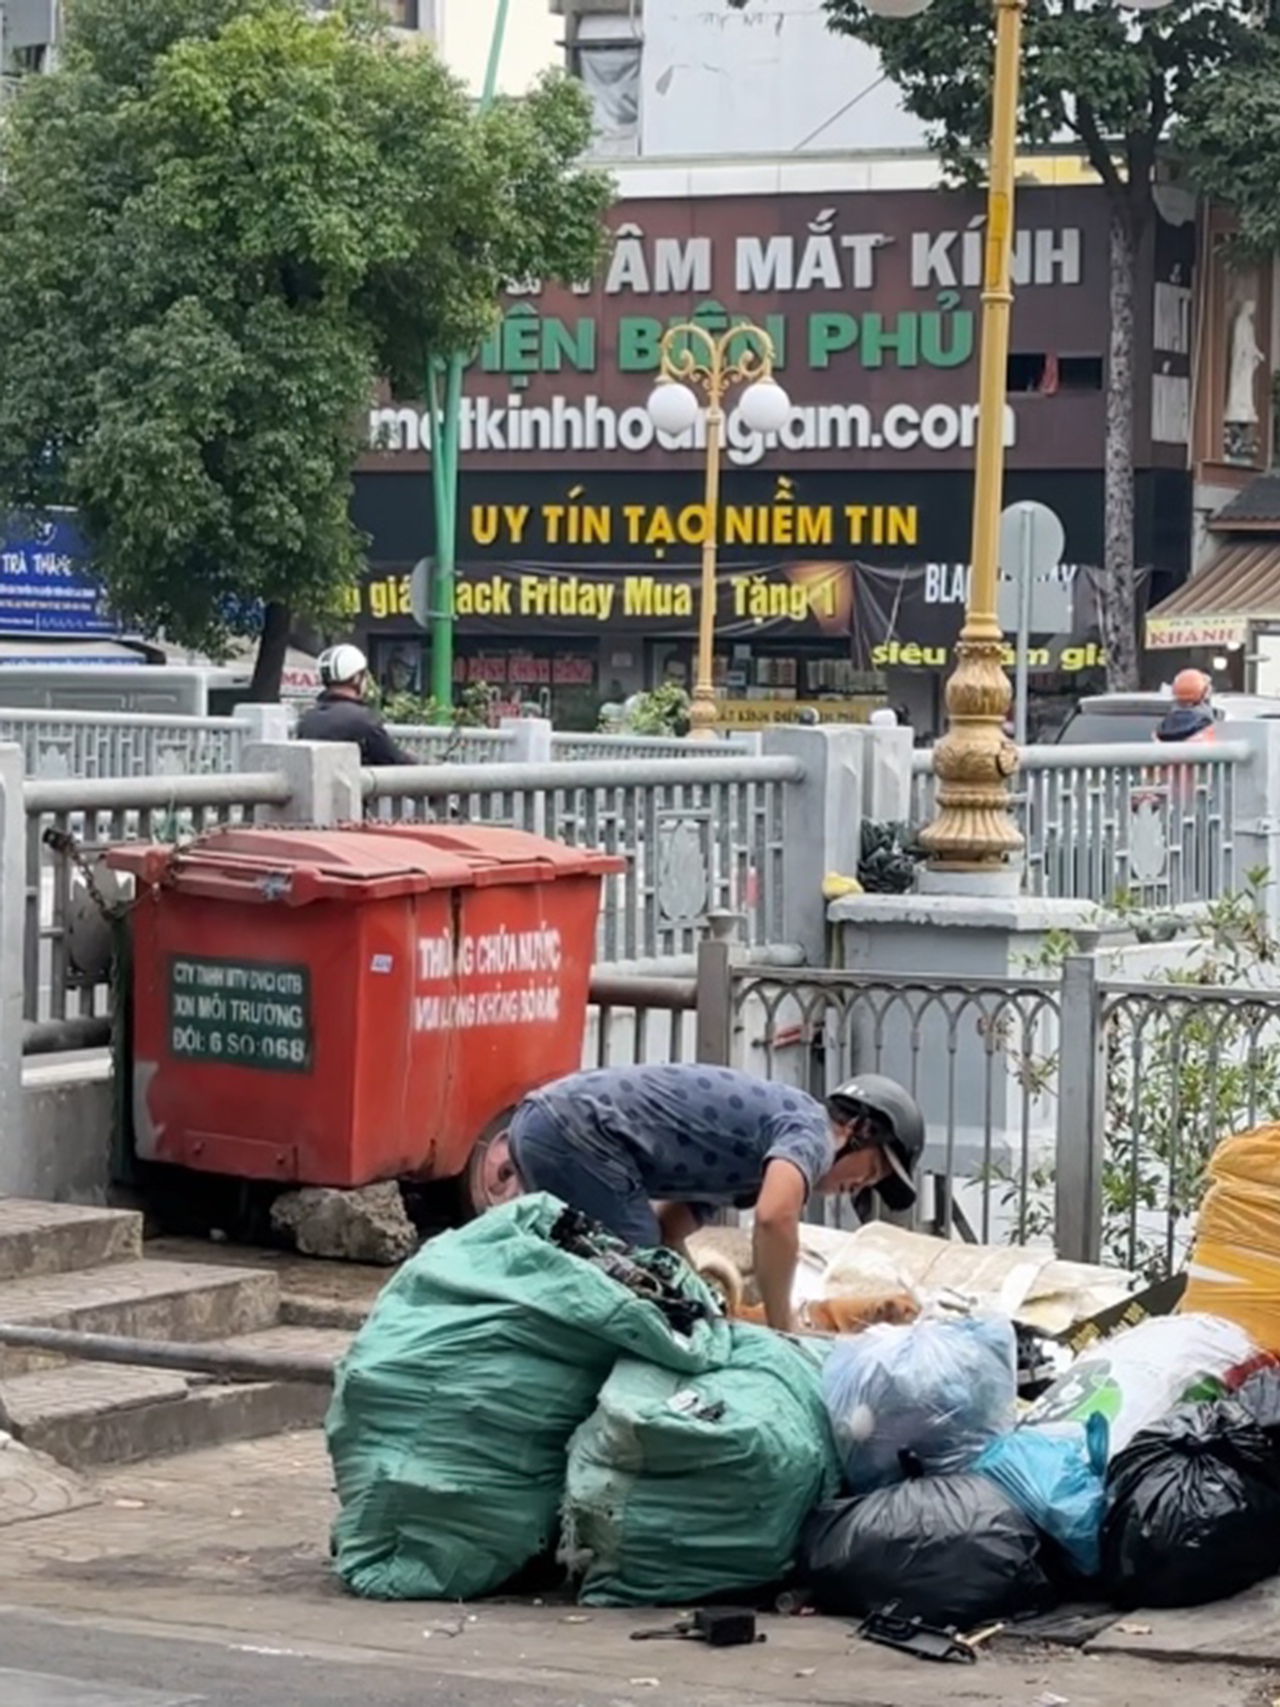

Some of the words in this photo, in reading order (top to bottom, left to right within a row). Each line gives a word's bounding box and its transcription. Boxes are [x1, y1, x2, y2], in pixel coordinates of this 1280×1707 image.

[573, 222, 711, 293] ÂM
[736, 208, 884, 292] MẮT
[480, 302, 595, 388] IỆN
[808, 291, 974, 367] PHỦ
[370, 394, 1016, 466] mtkinhhoangam.com
[471, 505, 529, 545] UY
[542, 484, 611, 544] TÍN
[623, 504, 713, 559] TẠO
[725, 475, 832, 545] NIỀM
[845, 505, 917, 545] TIN
[455, 575, 513, 616] ack
[520, 575, 613, 621] Friday
[624, 577, 693, 616] Mua
[731, 574, 808, 624] Tặng
[925, 564, 973, 603] BLA
[872, 642, 946, 666] siêu
